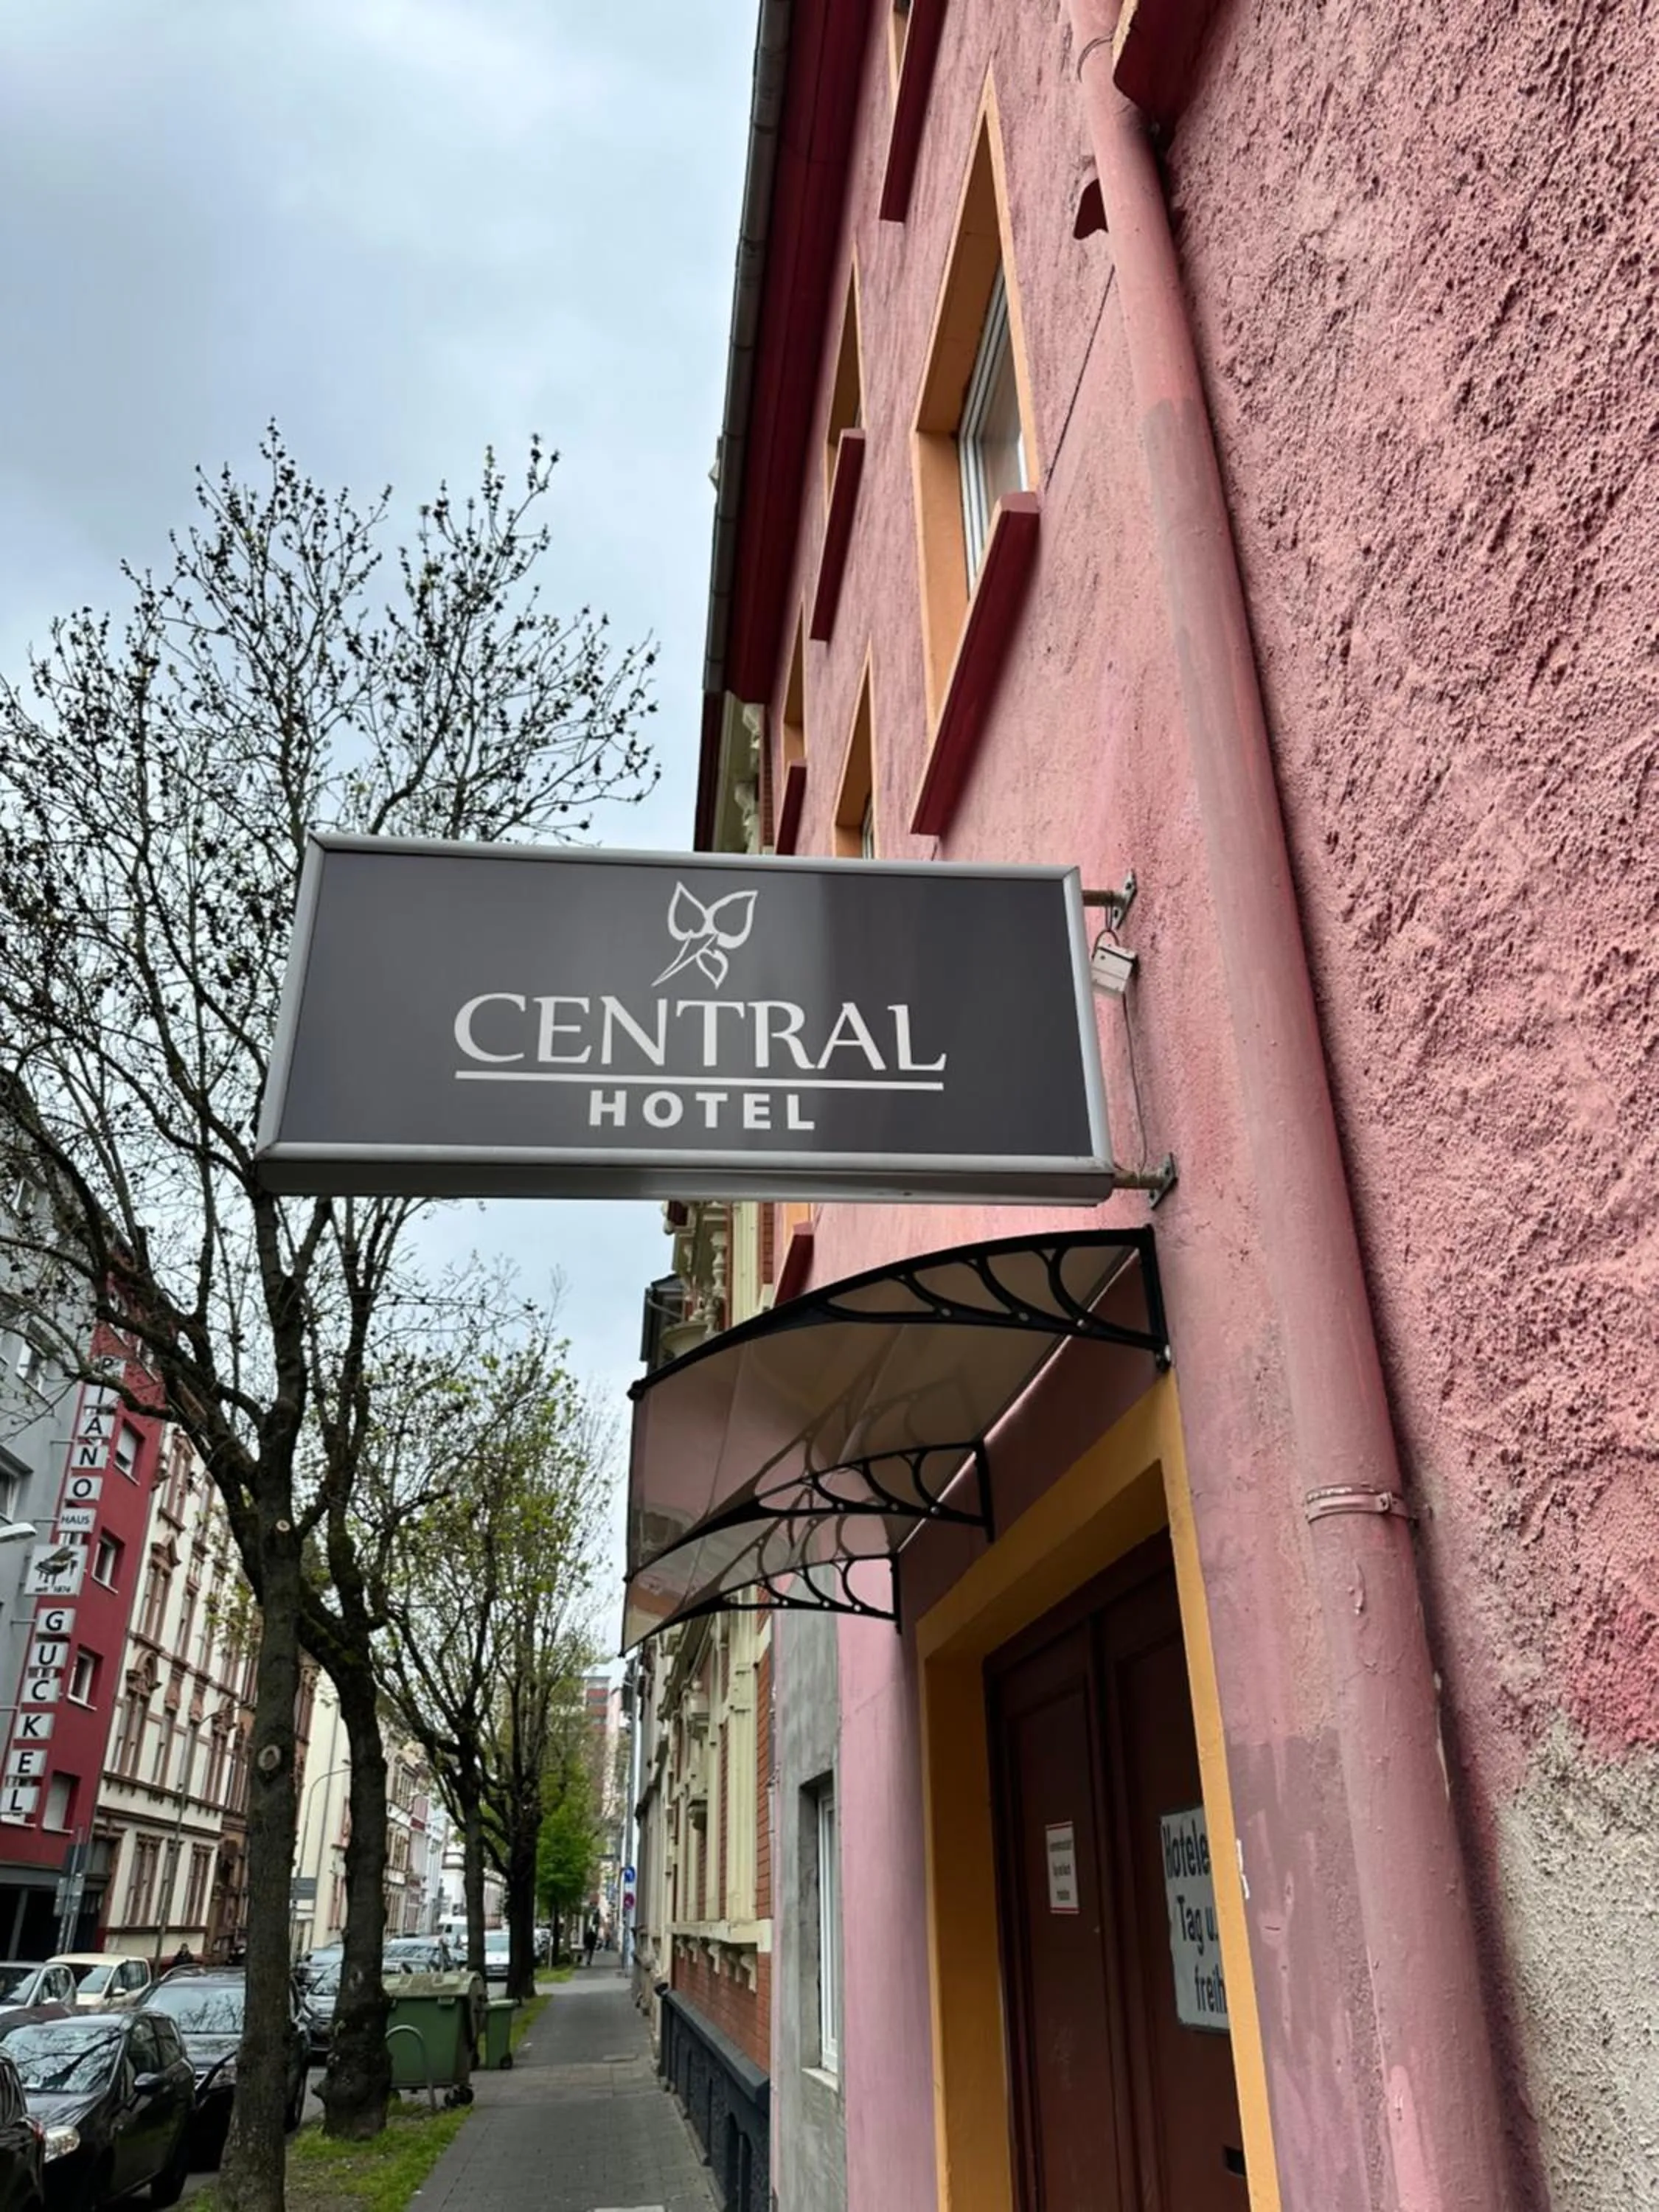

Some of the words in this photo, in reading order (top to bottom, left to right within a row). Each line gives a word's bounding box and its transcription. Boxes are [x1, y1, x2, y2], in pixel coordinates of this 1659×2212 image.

[453, 992, 947, 1071] CENTRAL
[590, 1089, 815, 1130] HOTEL
[61, 1515, 90, 1525] HAUS
[9, 1610, 64, 1812] GUCKEL
[1176, 1894, 1204, 1955] Tag
